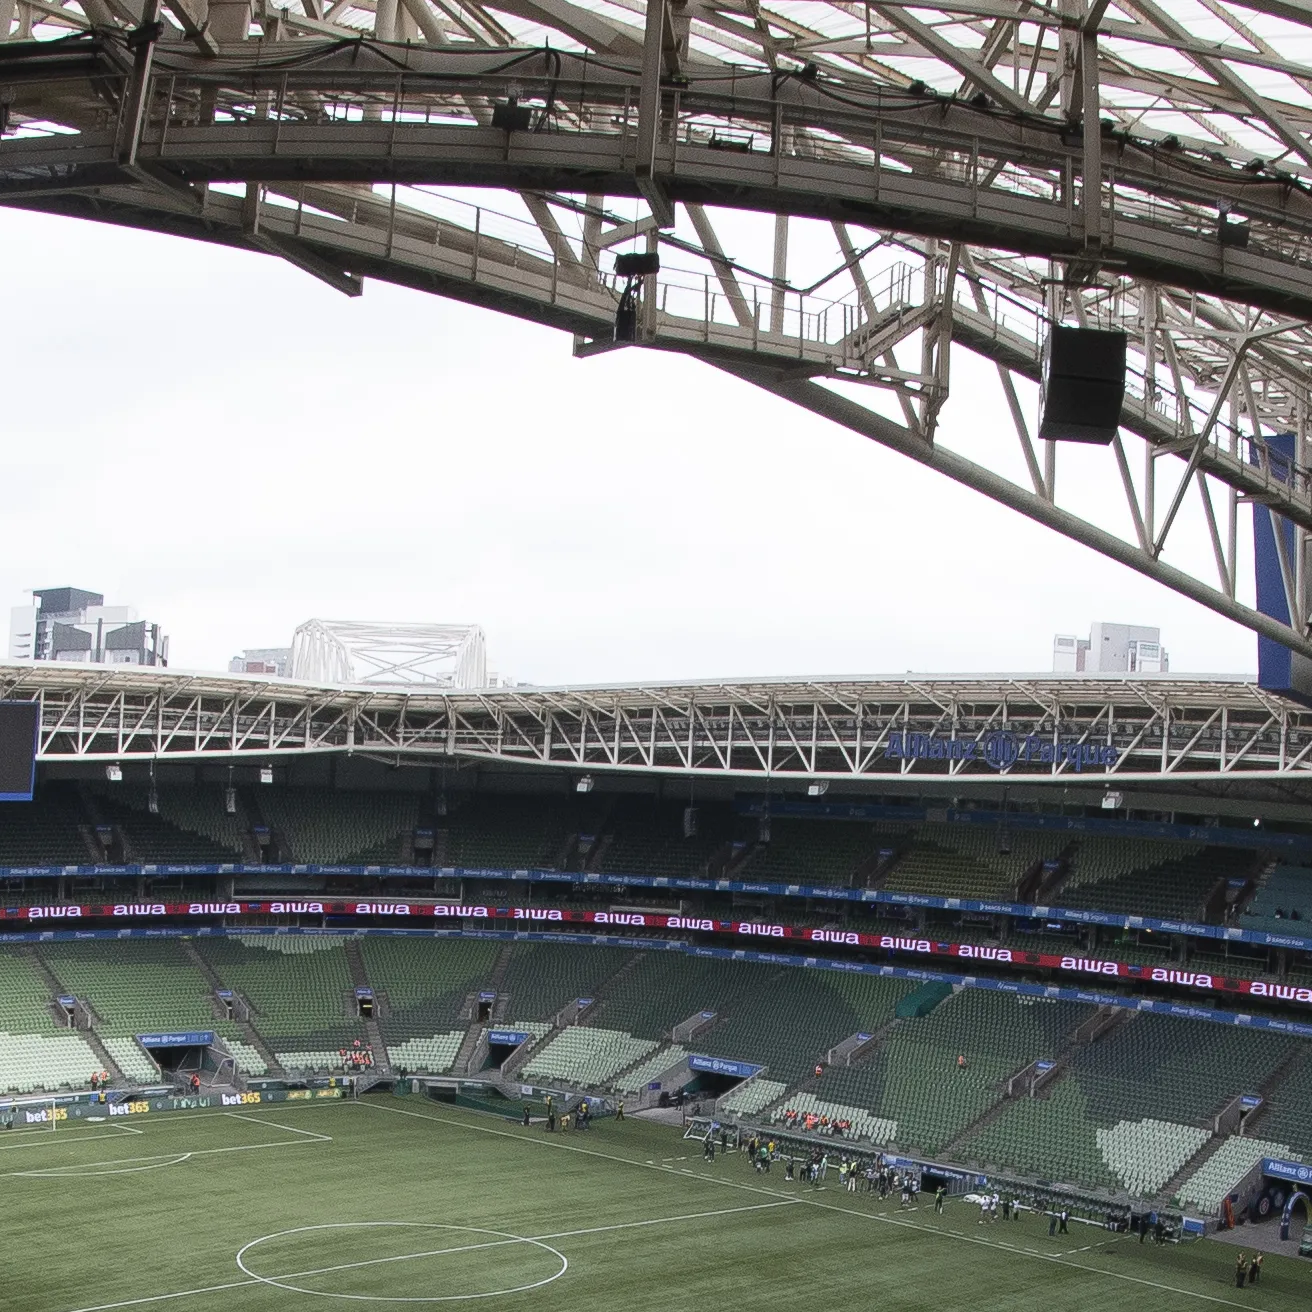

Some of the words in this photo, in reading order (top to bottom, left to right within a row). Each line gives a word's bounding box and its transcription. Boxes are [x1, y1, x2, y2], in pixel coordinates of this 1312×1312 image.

[884, 733, 978, 761] Allianz
[1025, 735, 1118, 772] Parque
[28, 906, 81, 918] aiwa
[113, 904, 166, 915] aiwa
[189, 903, 241, 914] aiwa
[270, 902, 323, 913] aiwa
[356, 903, 410, 914] aiwa
[434, 905, 488, 917] aiwa
[515, 908, 562, 920] aiwa
[594, 912, 645, 925] aiwa
[667, 917, 713, 930] aiwa
[739, 923, 784, 937] aiwa
[811, 929, 859, 944] aiwa
[880, 936, 931, 952] aiwa
[958, 945, 1012, 962] aiwa
[1061, 957, 1119, 975] aiwa
[1151, 968, 1212, 988] aiwa
[1250, 982, 1312, 1003] aiwa
[692, 1058, 711, 1068] Allianz
[720, 1062, 738, 1072] Parque
[221, 1091, 261, 1105] bet365
[109, 1102, 149, 1116] bet365
[1268, 1162, 1297, 1175] Allianz
